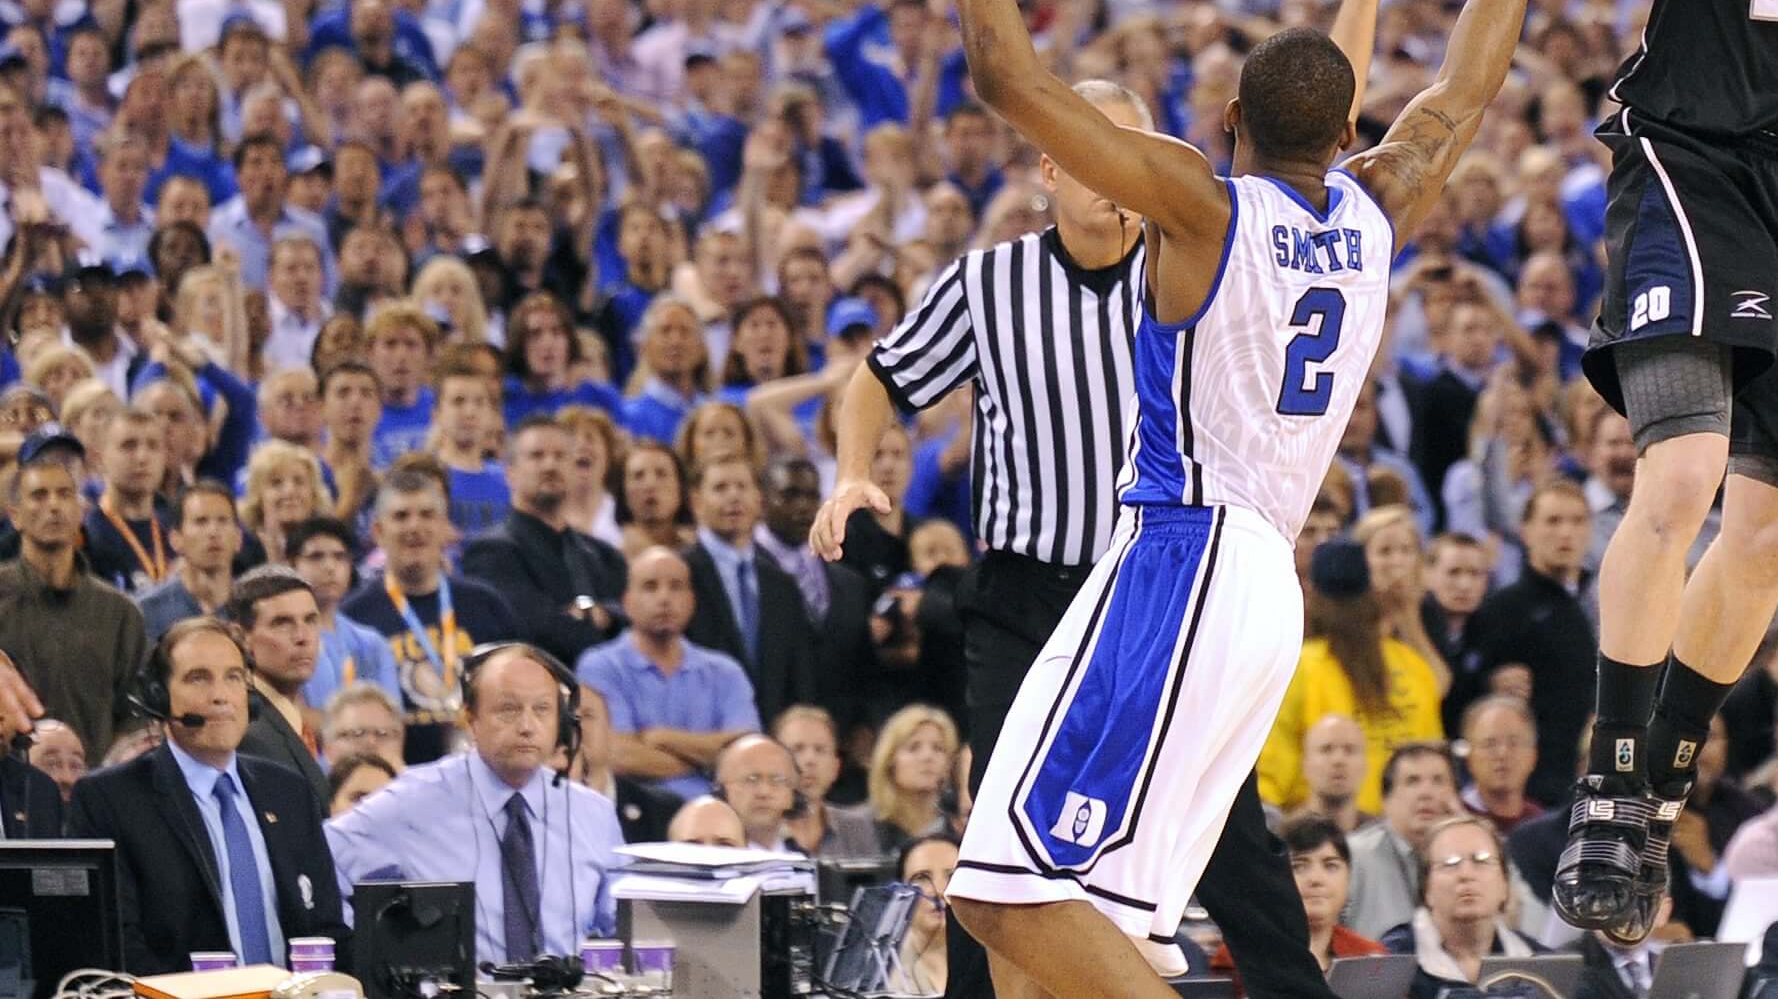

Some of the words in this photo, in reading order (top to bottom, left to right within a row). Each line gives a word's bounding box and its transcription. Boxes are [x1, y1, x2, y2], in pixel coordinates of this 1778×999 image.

[1272, 224, 1362, 274] SMTH
[1630, 285, 1671, 332] 20
[1275, 286, 1346, 416] 2
